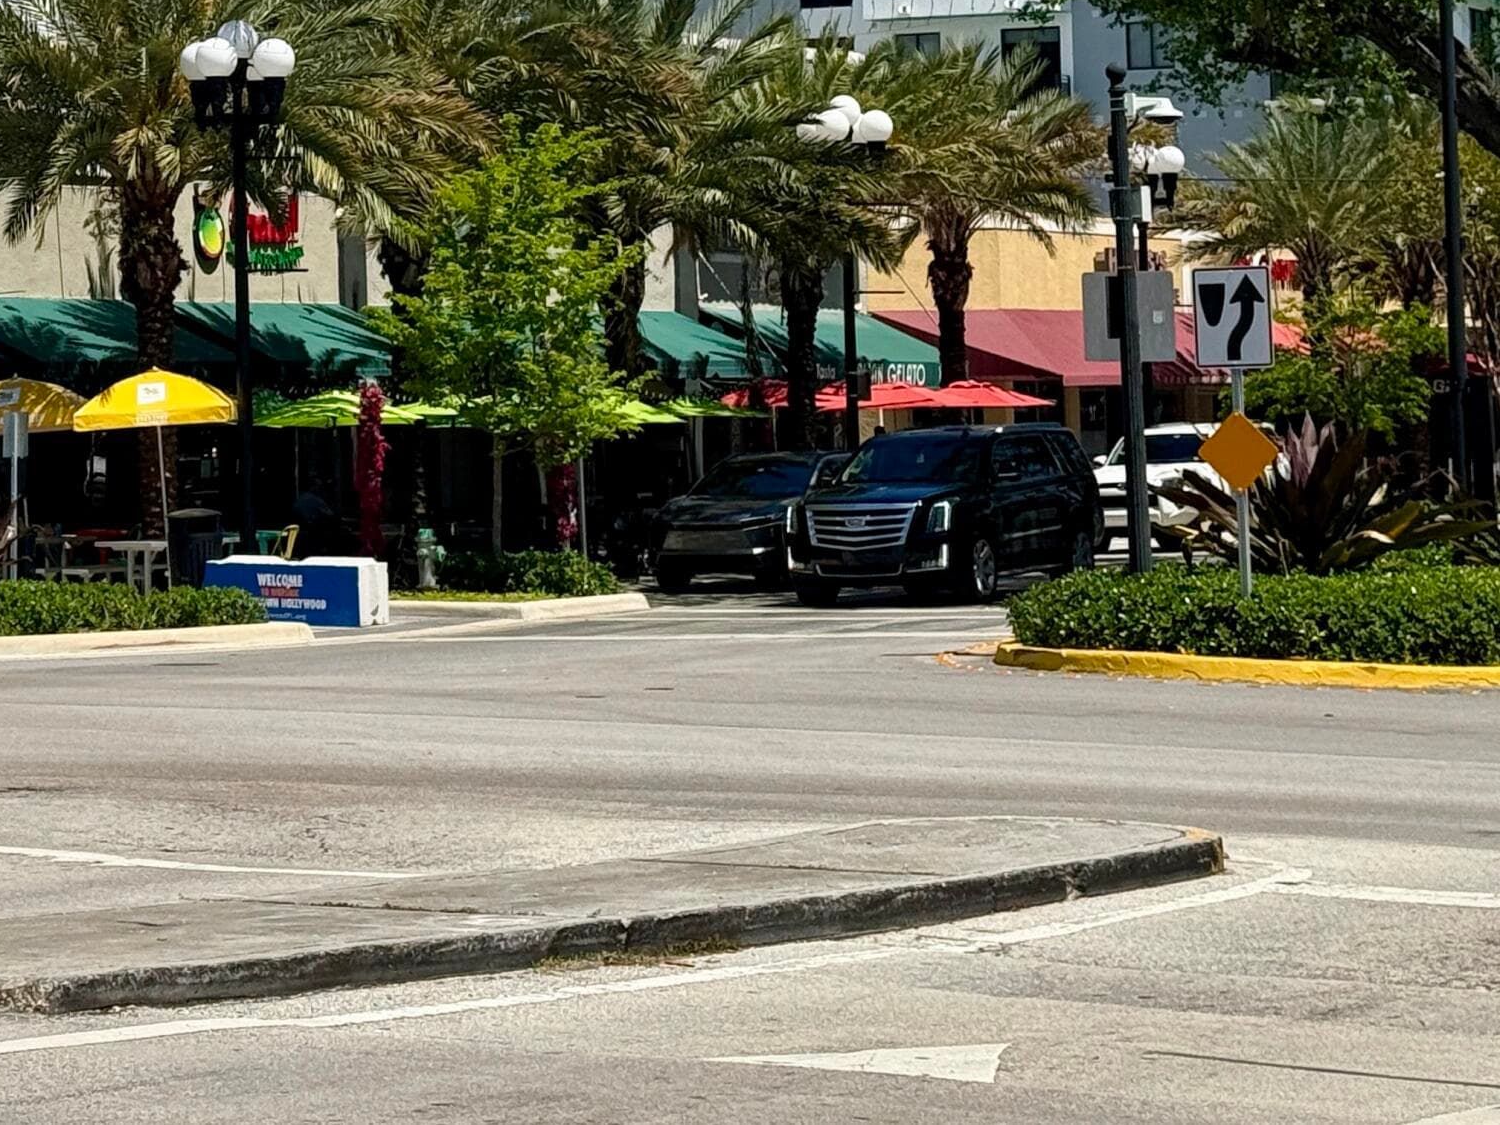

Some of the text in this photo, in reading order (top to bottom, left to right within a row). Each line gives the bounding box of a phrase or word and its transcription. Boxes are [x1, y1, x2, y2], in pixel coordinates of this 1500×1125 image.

[887, 363, 926, 386] GELATO
[256, 573, 303, 588] WELCOME
[281, 598, 327, 610] HOLLYWOOD
